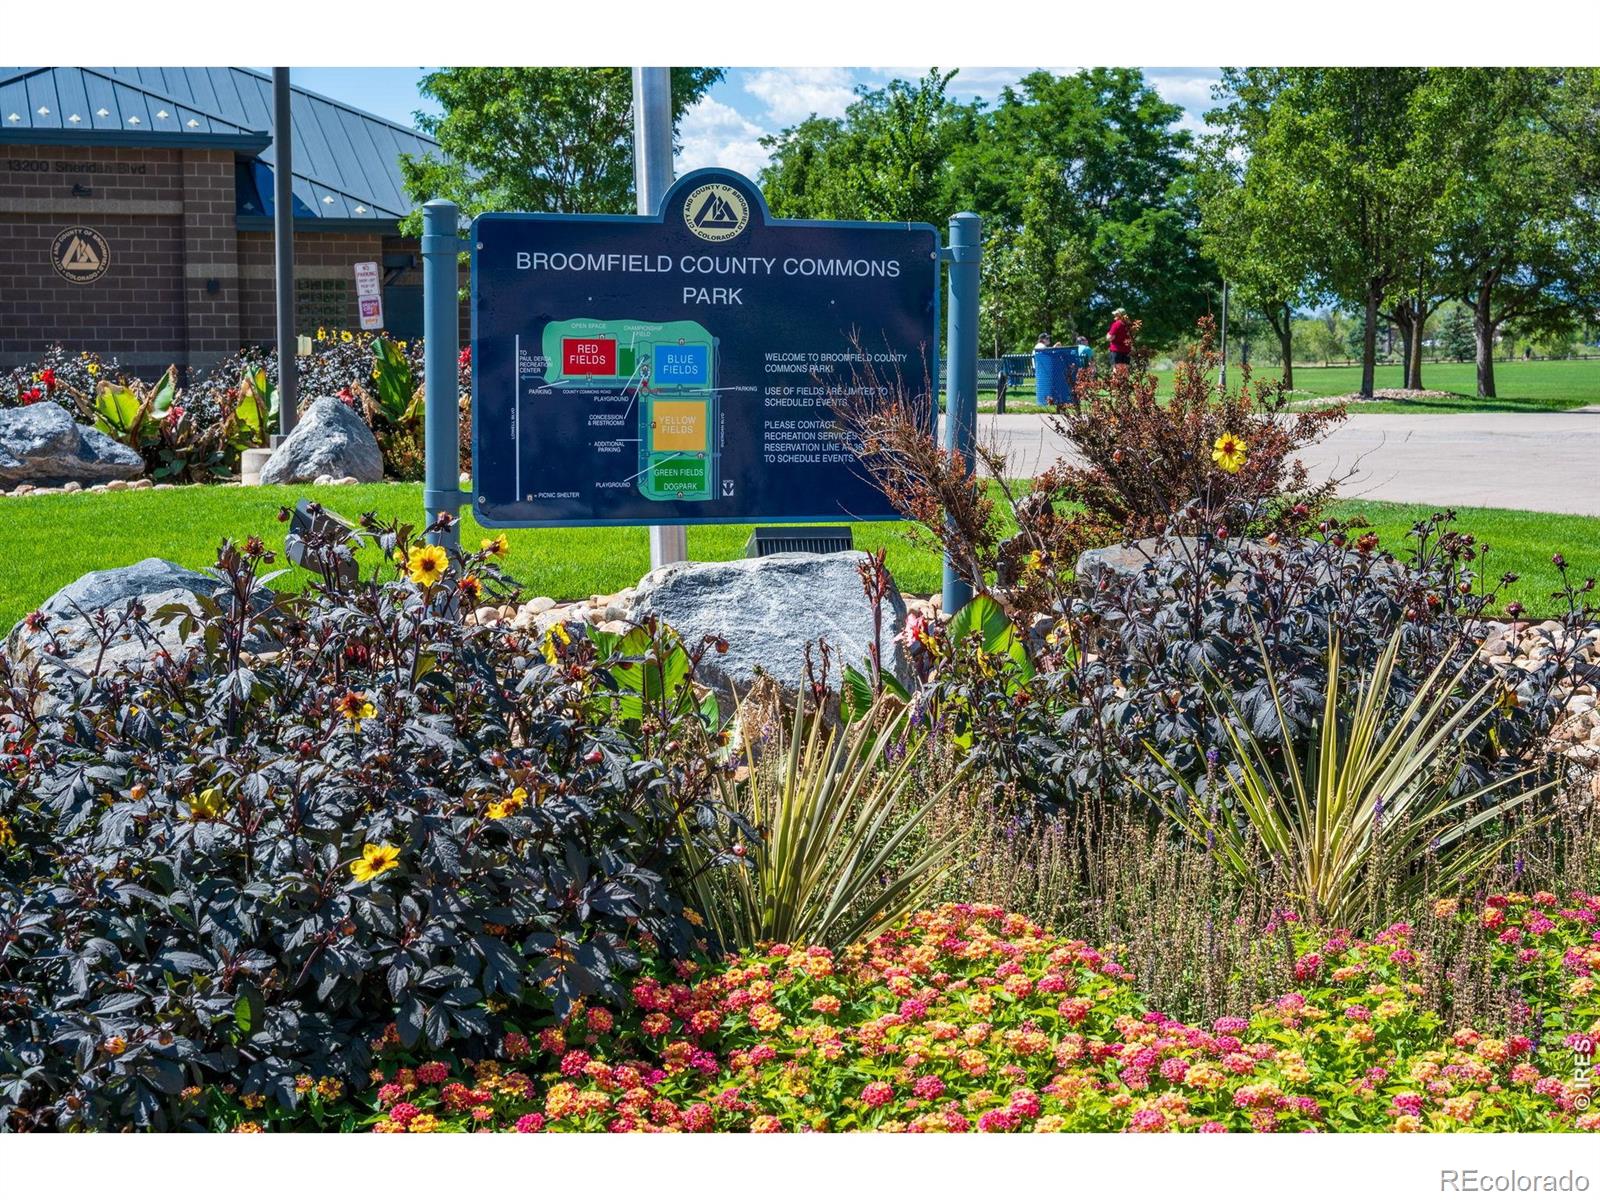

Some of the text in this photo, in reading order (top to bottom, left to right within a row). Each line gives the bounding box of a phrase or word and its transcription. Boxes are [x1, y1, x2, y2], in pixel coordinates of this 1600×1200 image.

[8, 160, 146, 174] 13200 Sheridan Blvd
[692, 185, 720, 198] COUNTY
[685, 198, 694, 212] AND
[732, 190, 748, 230] BROOMFIELD
[685, 214, 695, 229] CITY
[59, 229, 82, 241] COUNTY
[698, 231, 735, 240] COLORADO
[516, 252, 900, 277] BROOMFIELD COUNTY COMMONS
[66, 272, 97, 280] COLORADO
[683, 287, 743, 305] PARK
[577, 344, 598, 354] RED
[569, 355, 606, 365] FIELDS
[667, 355, 693, 363] BLUE
[765, 353, 806, 361] WELCOME
[808, 353, 819, 361] TO
[874, 354, 907, 362] COUNTY
[663, 365, 698, 375] FIELDS
[765, 364, 807, 373] COMMONS
[765, 387, 781, 395] USE
[783, 387, 794, 395] OF
[797, 387, 824, 395] FIELDS
[826, 387, 842, 395] ARE
[765, 398, 814, 407] SCHEDULED
[659, 416, 696, 424] YELLOW
[764, 421, 795, 429] PLEASE
[662, 426, 693, 434] FIELDS
[764, 432, 858, 440] RECREATION SERVICES
[764, 443, 820, 451] RESERVATION
[822, 443, 839, 451] LINE
[764, 454, 856, 463] TO SCHEDULE EVENTS.
